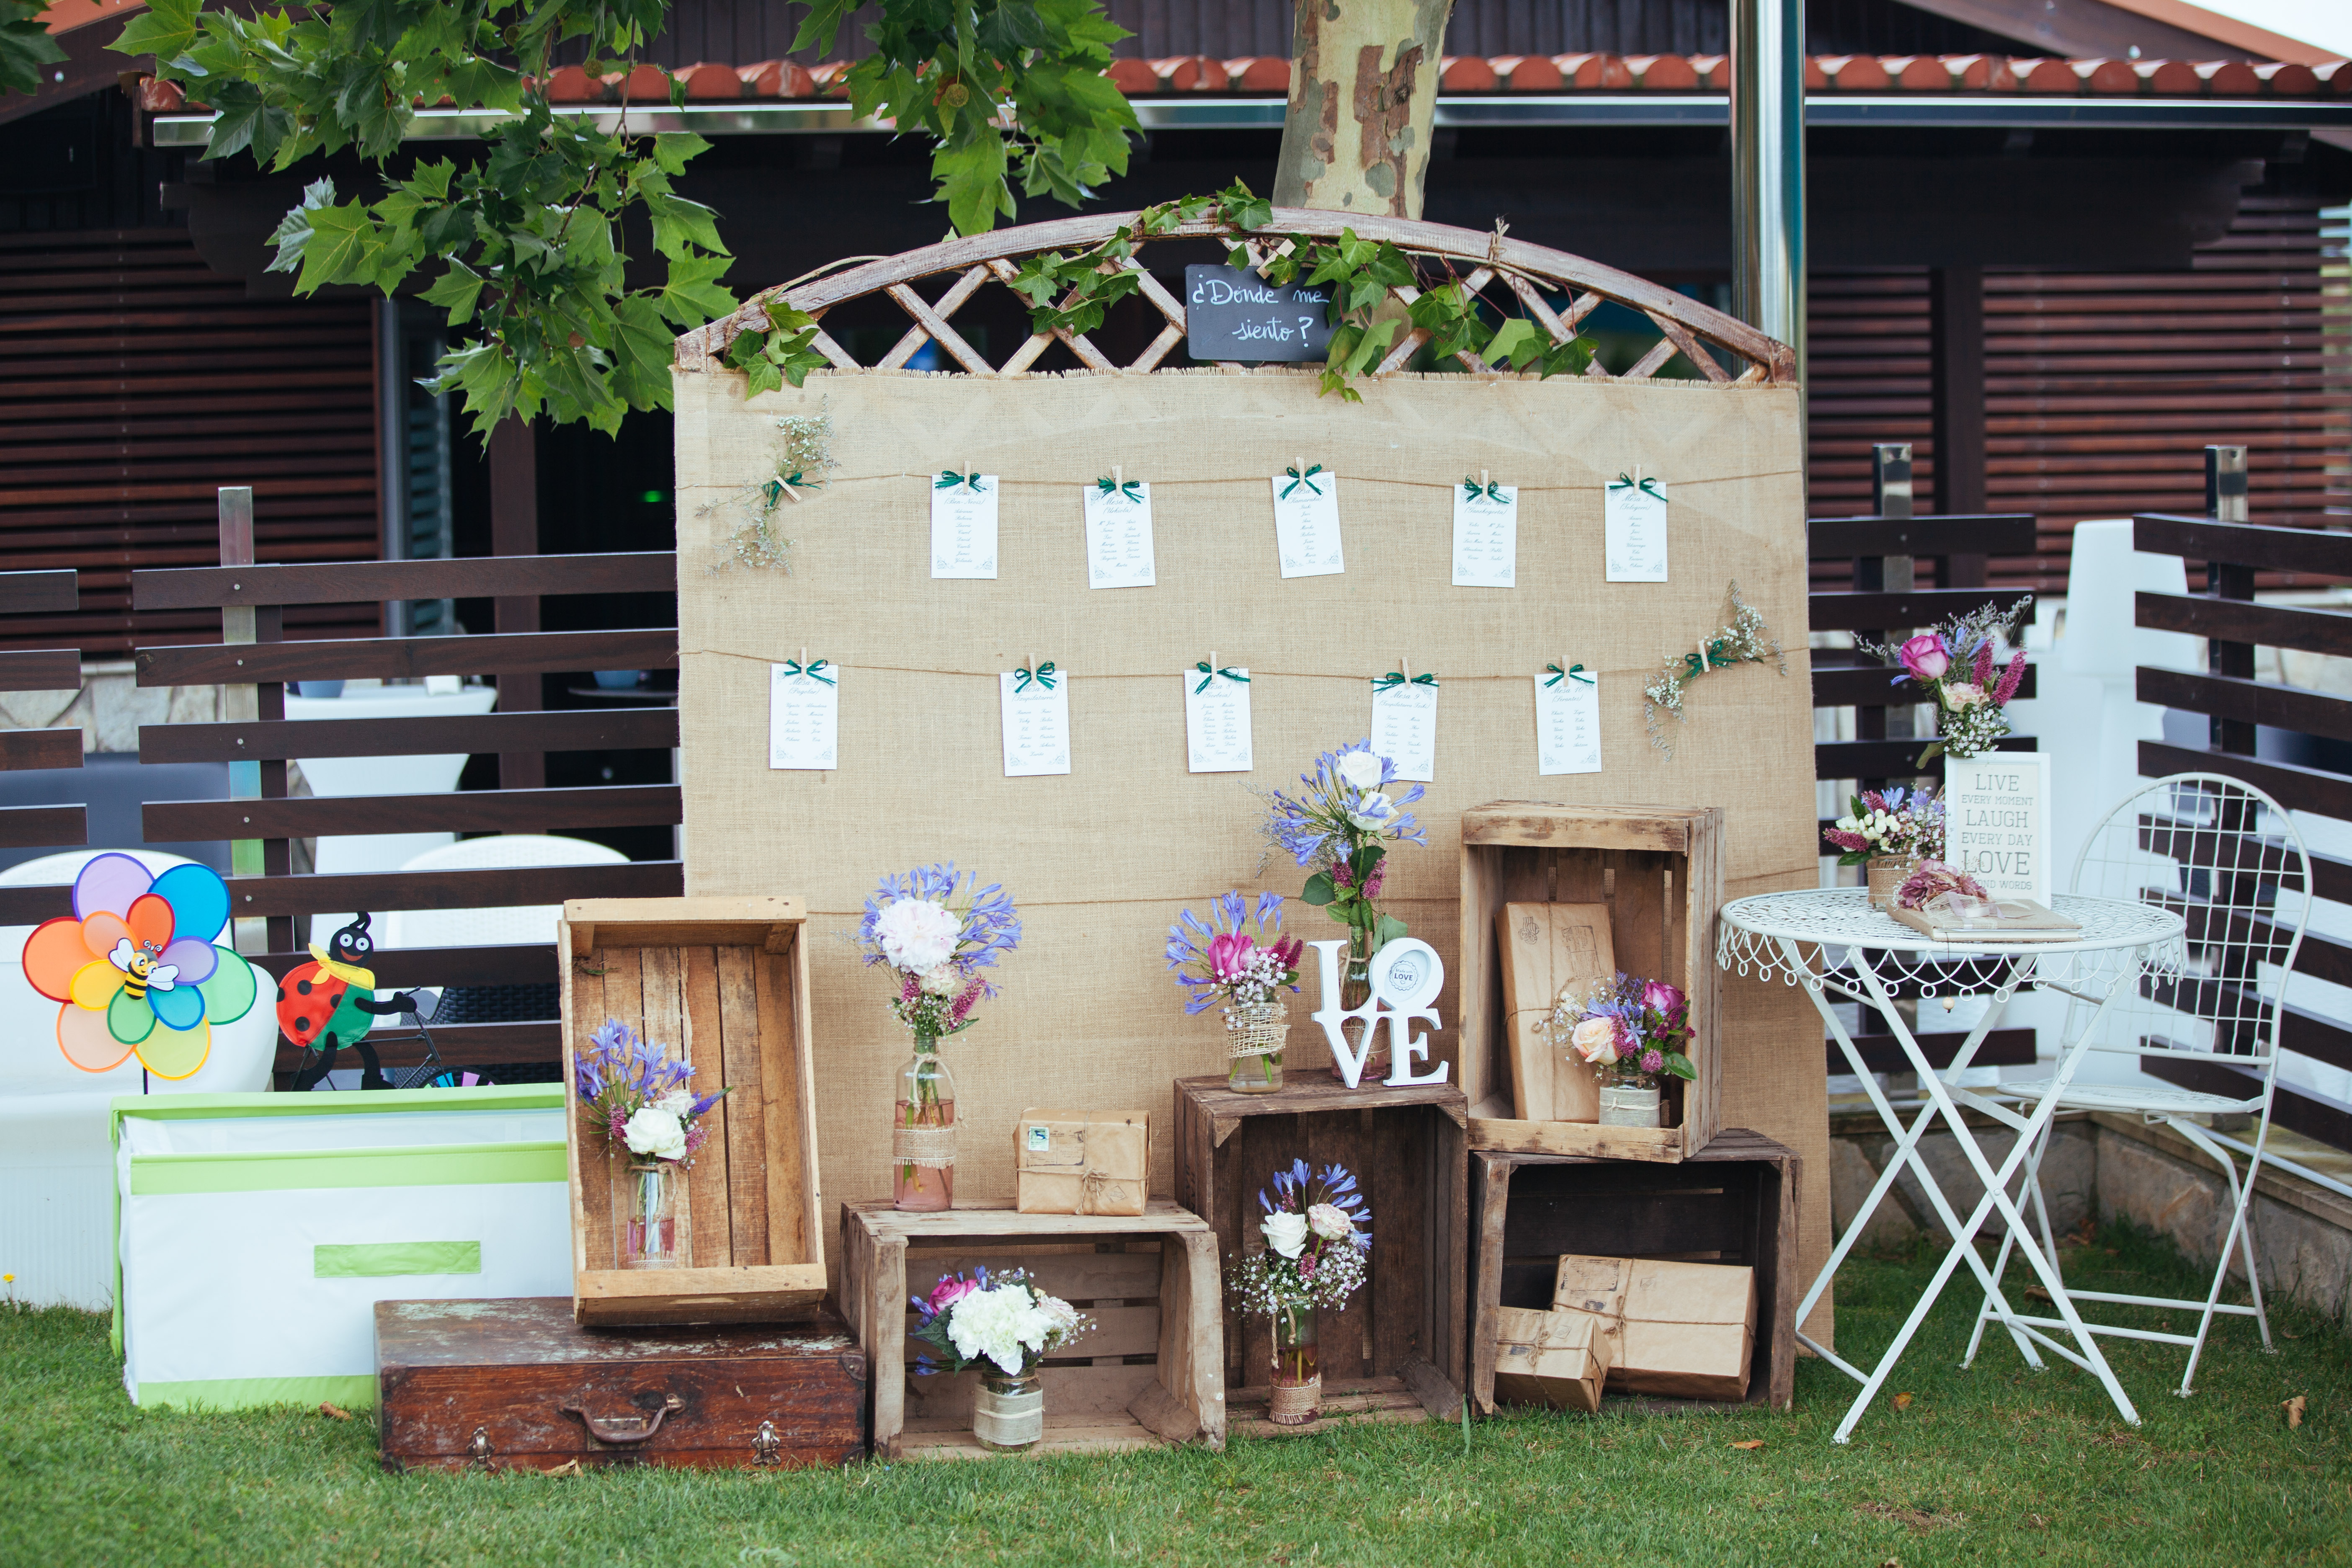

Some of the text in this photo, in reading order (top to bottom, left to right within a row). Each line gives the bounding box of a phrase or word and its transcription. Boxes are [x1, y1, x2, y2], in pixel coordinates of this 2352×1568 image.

[1293, 289, 1330, 303] me
[1103, 497, 1124, 505] Mesa
[789, 677, 810, 686] Mesa
[1390, 691, 1411, 699] Mesa
[1975, 774, 2019, 791] LIVE
[1962, 795, 2033, 806] EVERY MOMENT
[1966, 810, 2028, 828] LAUGH
[1961, 832, 2032, 846] EVERY DAY
[1963, 850, 2030, 875] LOVE
[2000, 881, 2032, 890] WORDS
